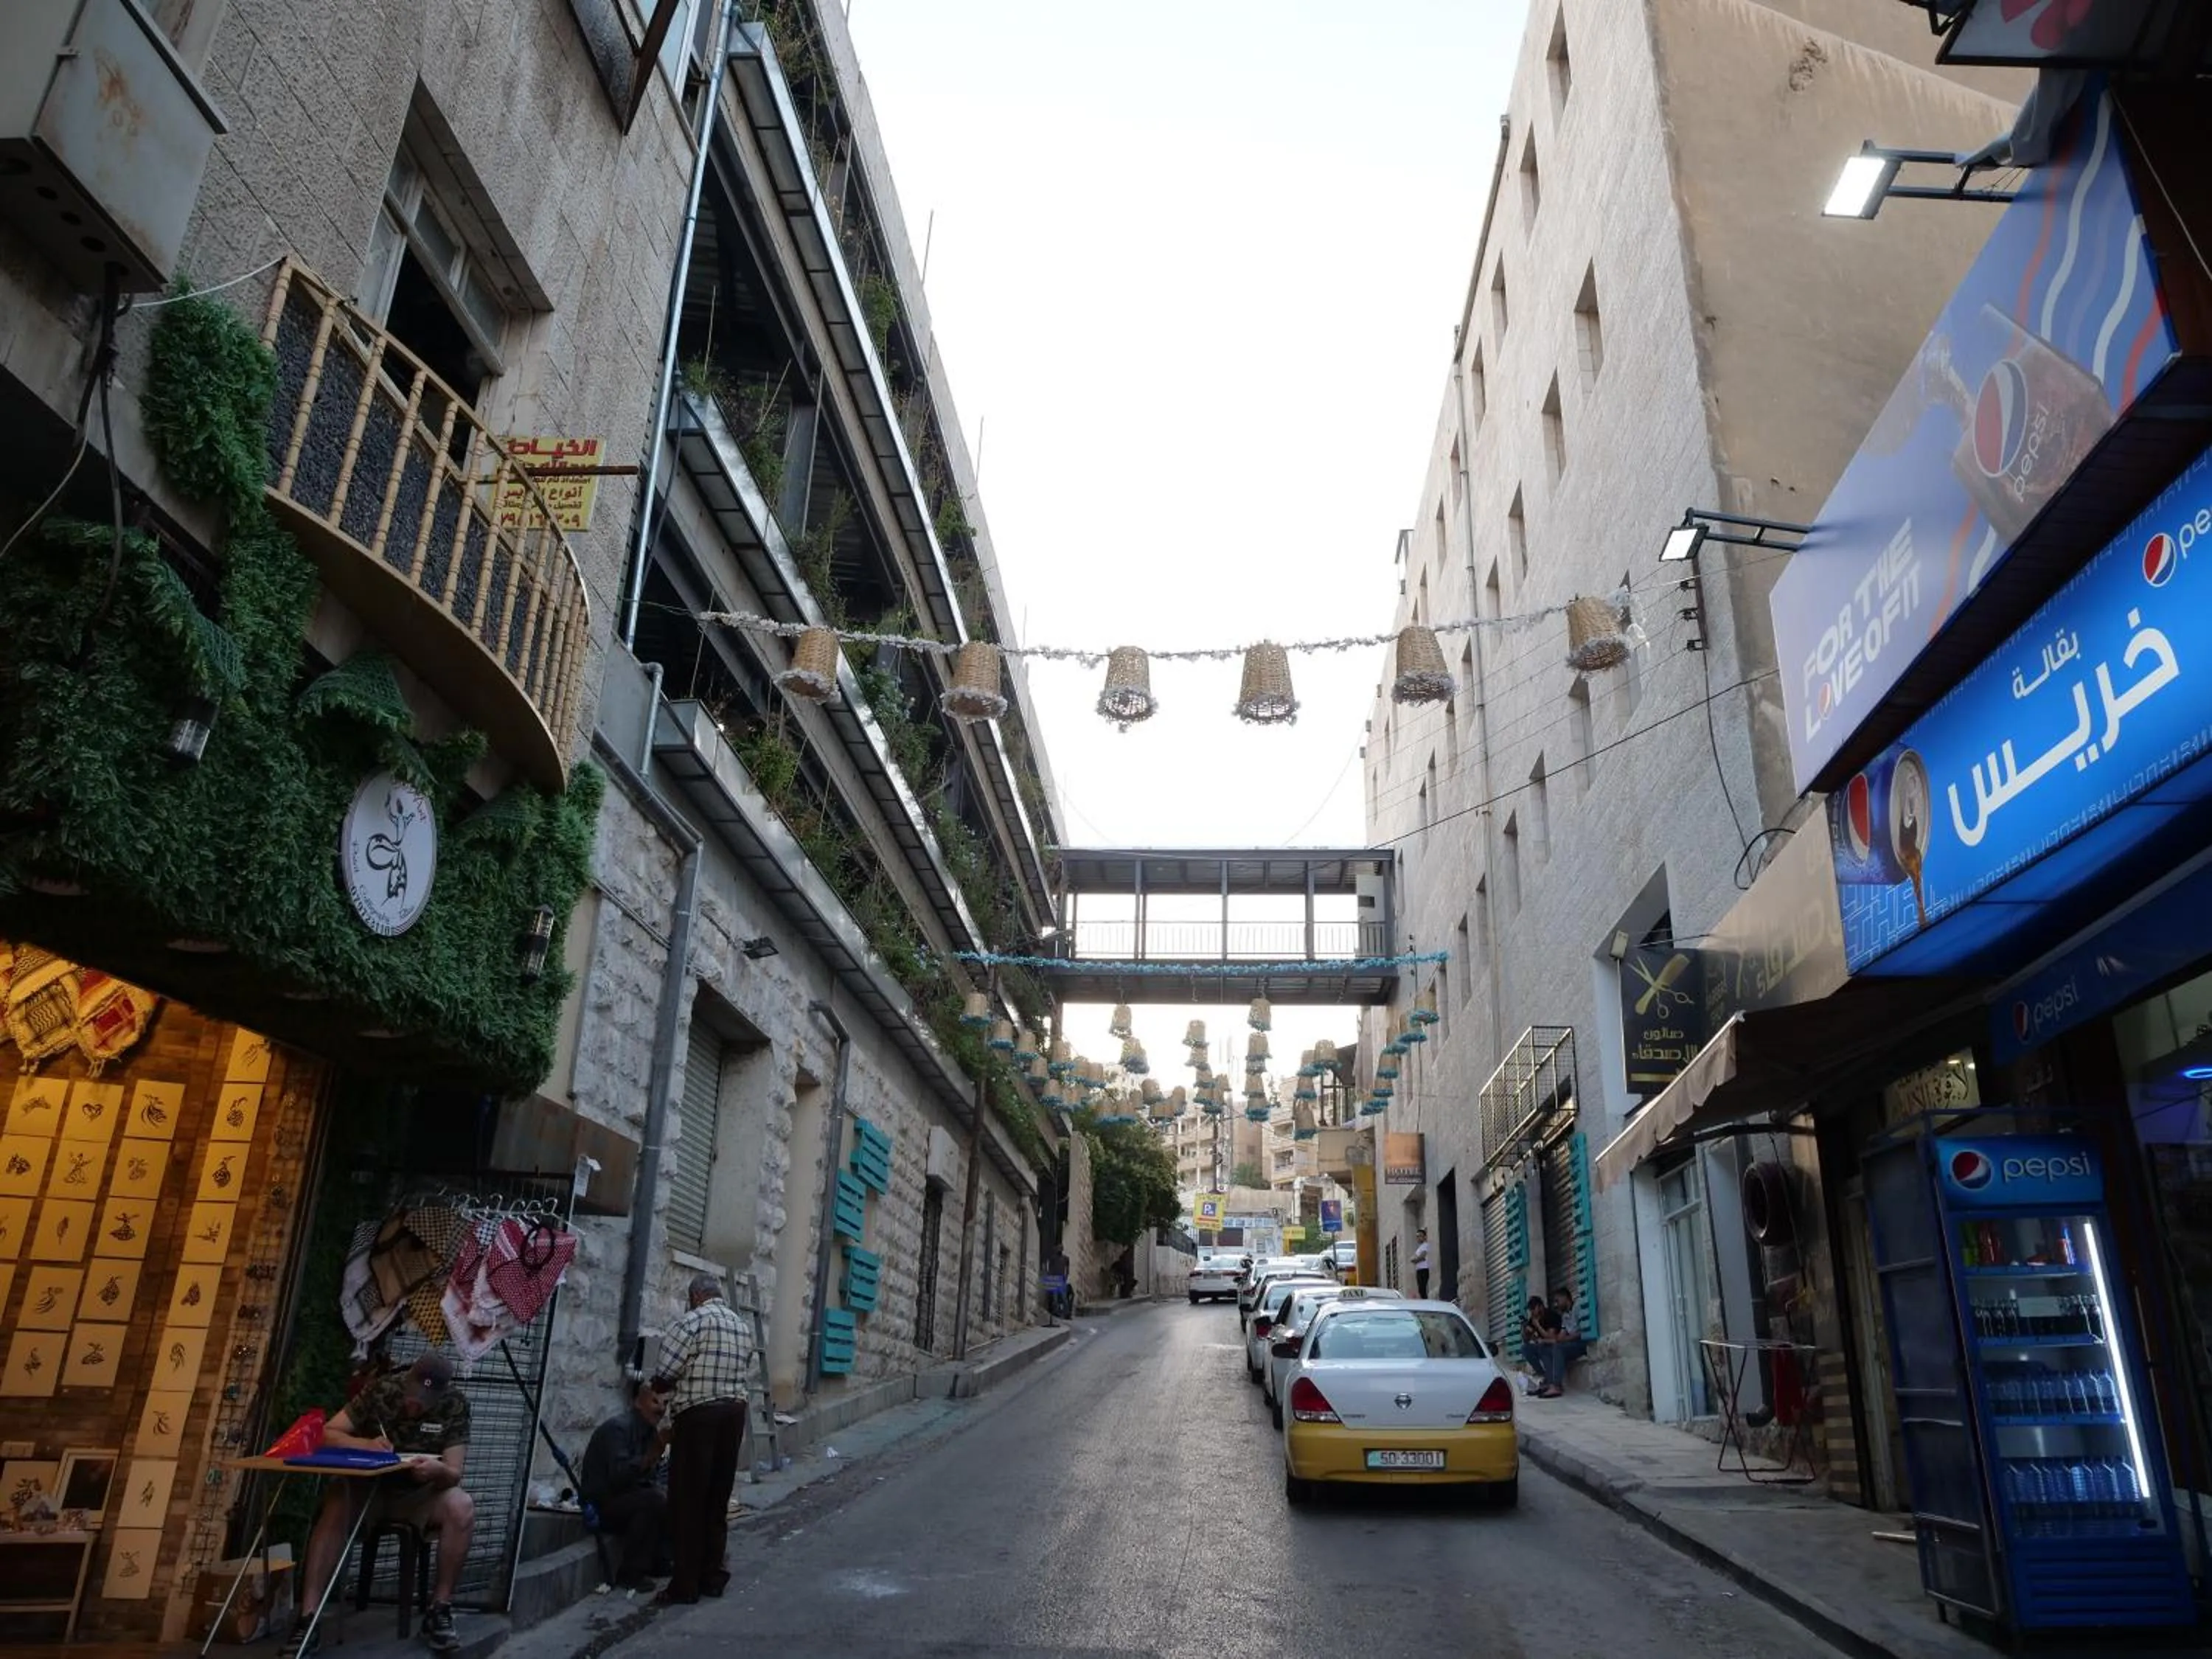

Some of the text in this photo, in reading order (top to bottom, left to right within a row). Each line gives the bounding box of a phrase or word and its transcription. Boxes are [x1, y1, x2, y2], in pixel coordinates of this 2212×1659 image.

[2014, 403, 2049, 502] pepsi
[2179, 508, 2212, 560] pe
[1804, 517, 1913, 698] FOR THE
[2012, 625, 2080, 700] بقالة
[1947, 608, 2180, 846] خريس
[1643, 1027, 1685, 1040] صالون
[2034, 977, 2079, 1031] pepsi
[2003, 1150, 2091, 1183] pepsi
